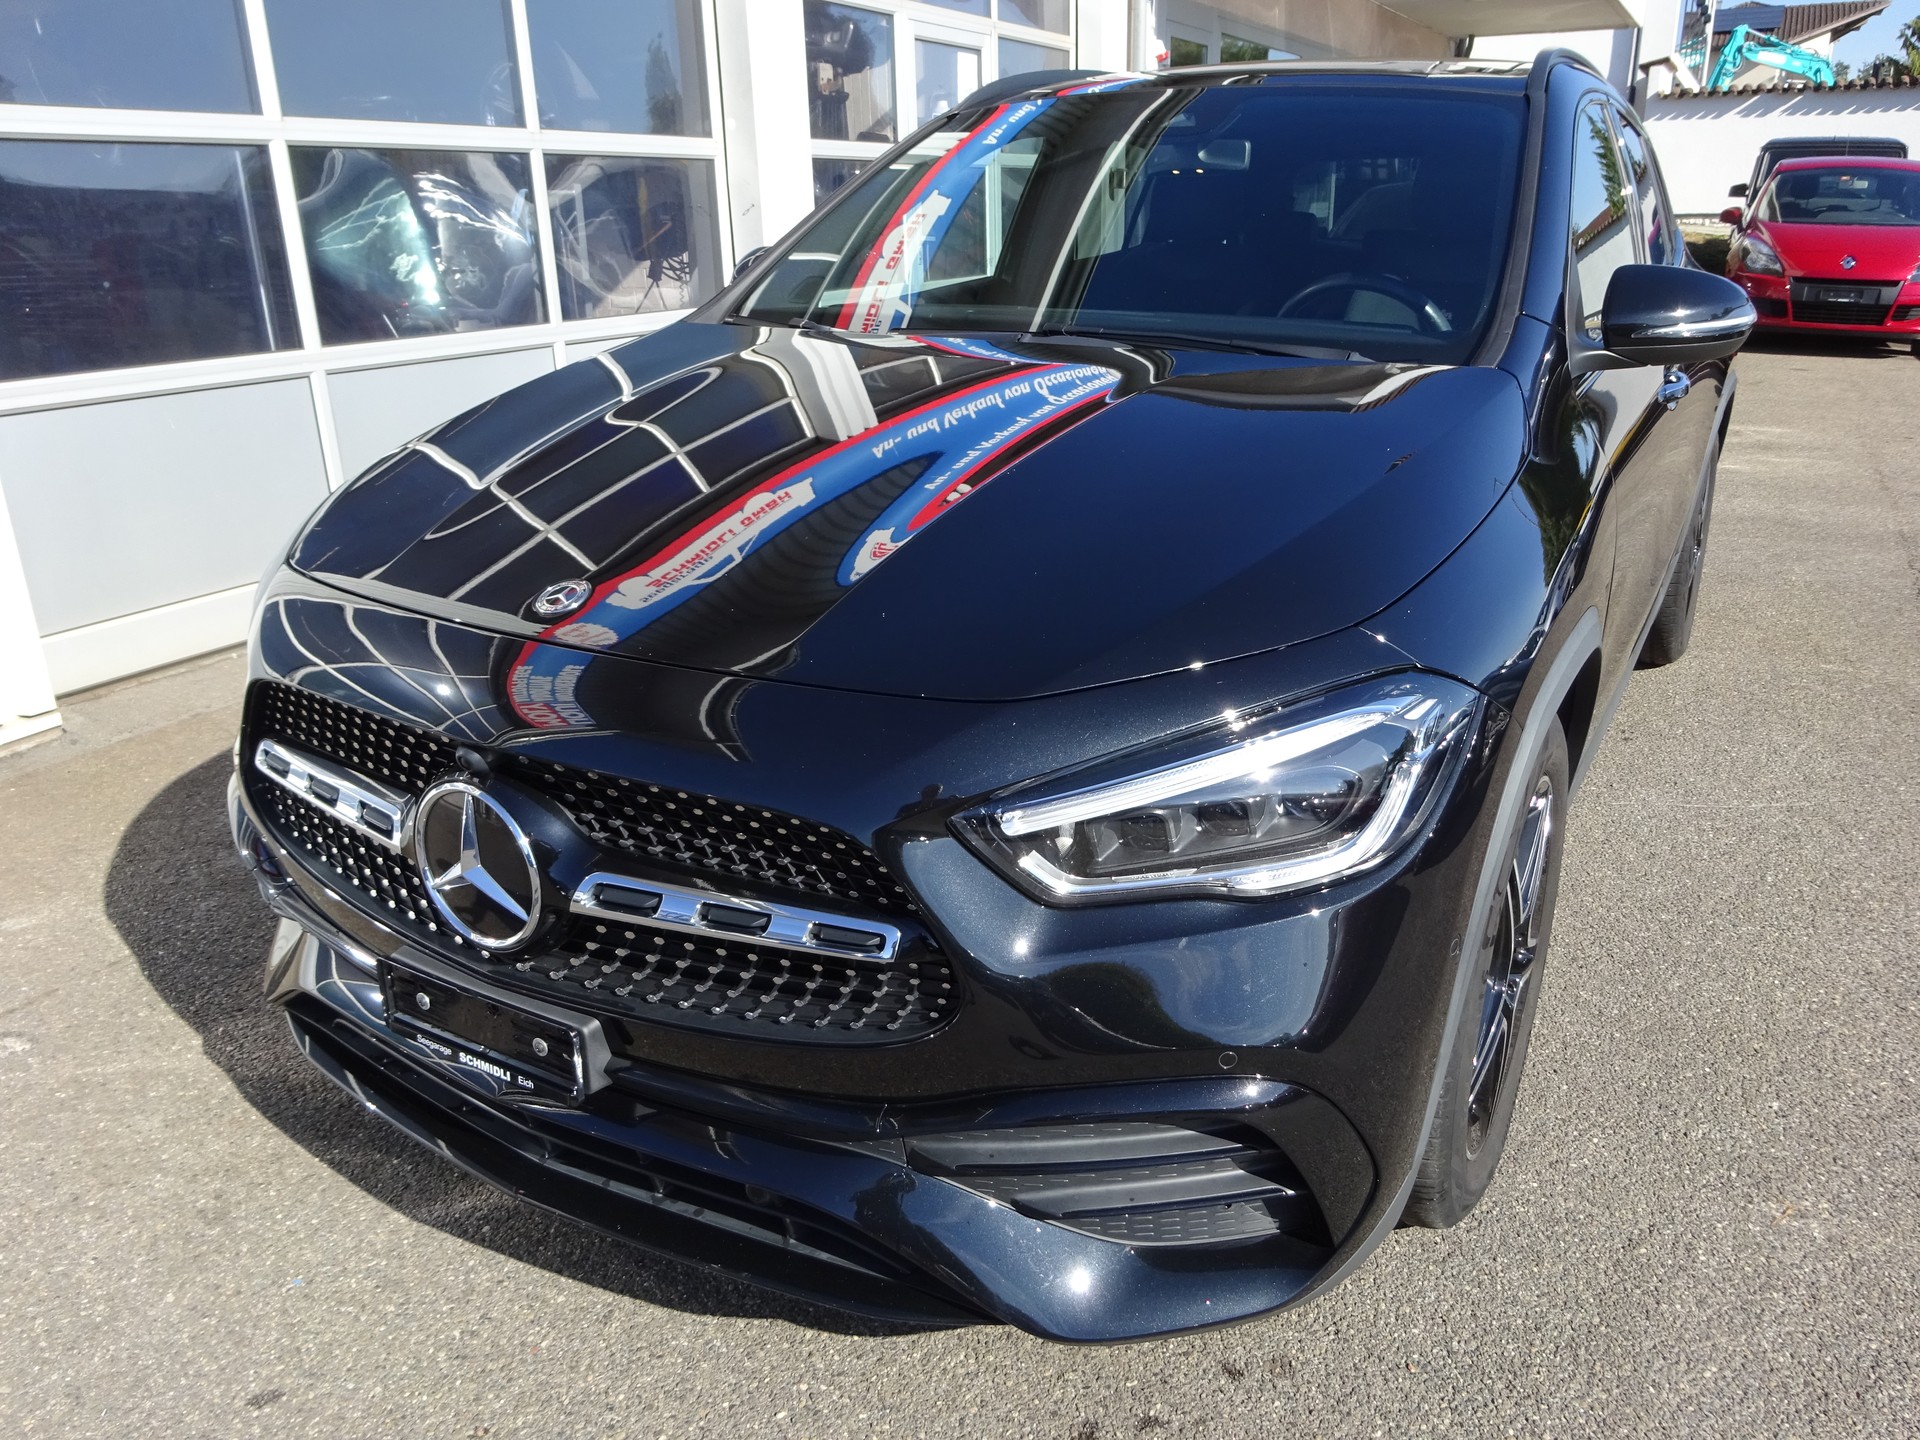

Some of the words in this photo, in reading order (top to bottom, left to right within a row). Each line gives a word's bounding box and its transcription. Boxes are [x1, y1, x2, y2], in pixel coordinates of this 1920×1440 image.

[924, 471, 951, 490] An-
[953, 450, 982, 469] und
[979, 415, 1032, 450] Verkauf
[1028, 403, 1054, 423] von
[416, 1034, 452, 1055] Seegarage
[459, 1052, 511, 1081] SCHMIDLI
[518, 1075, 534, 1089] Eich
